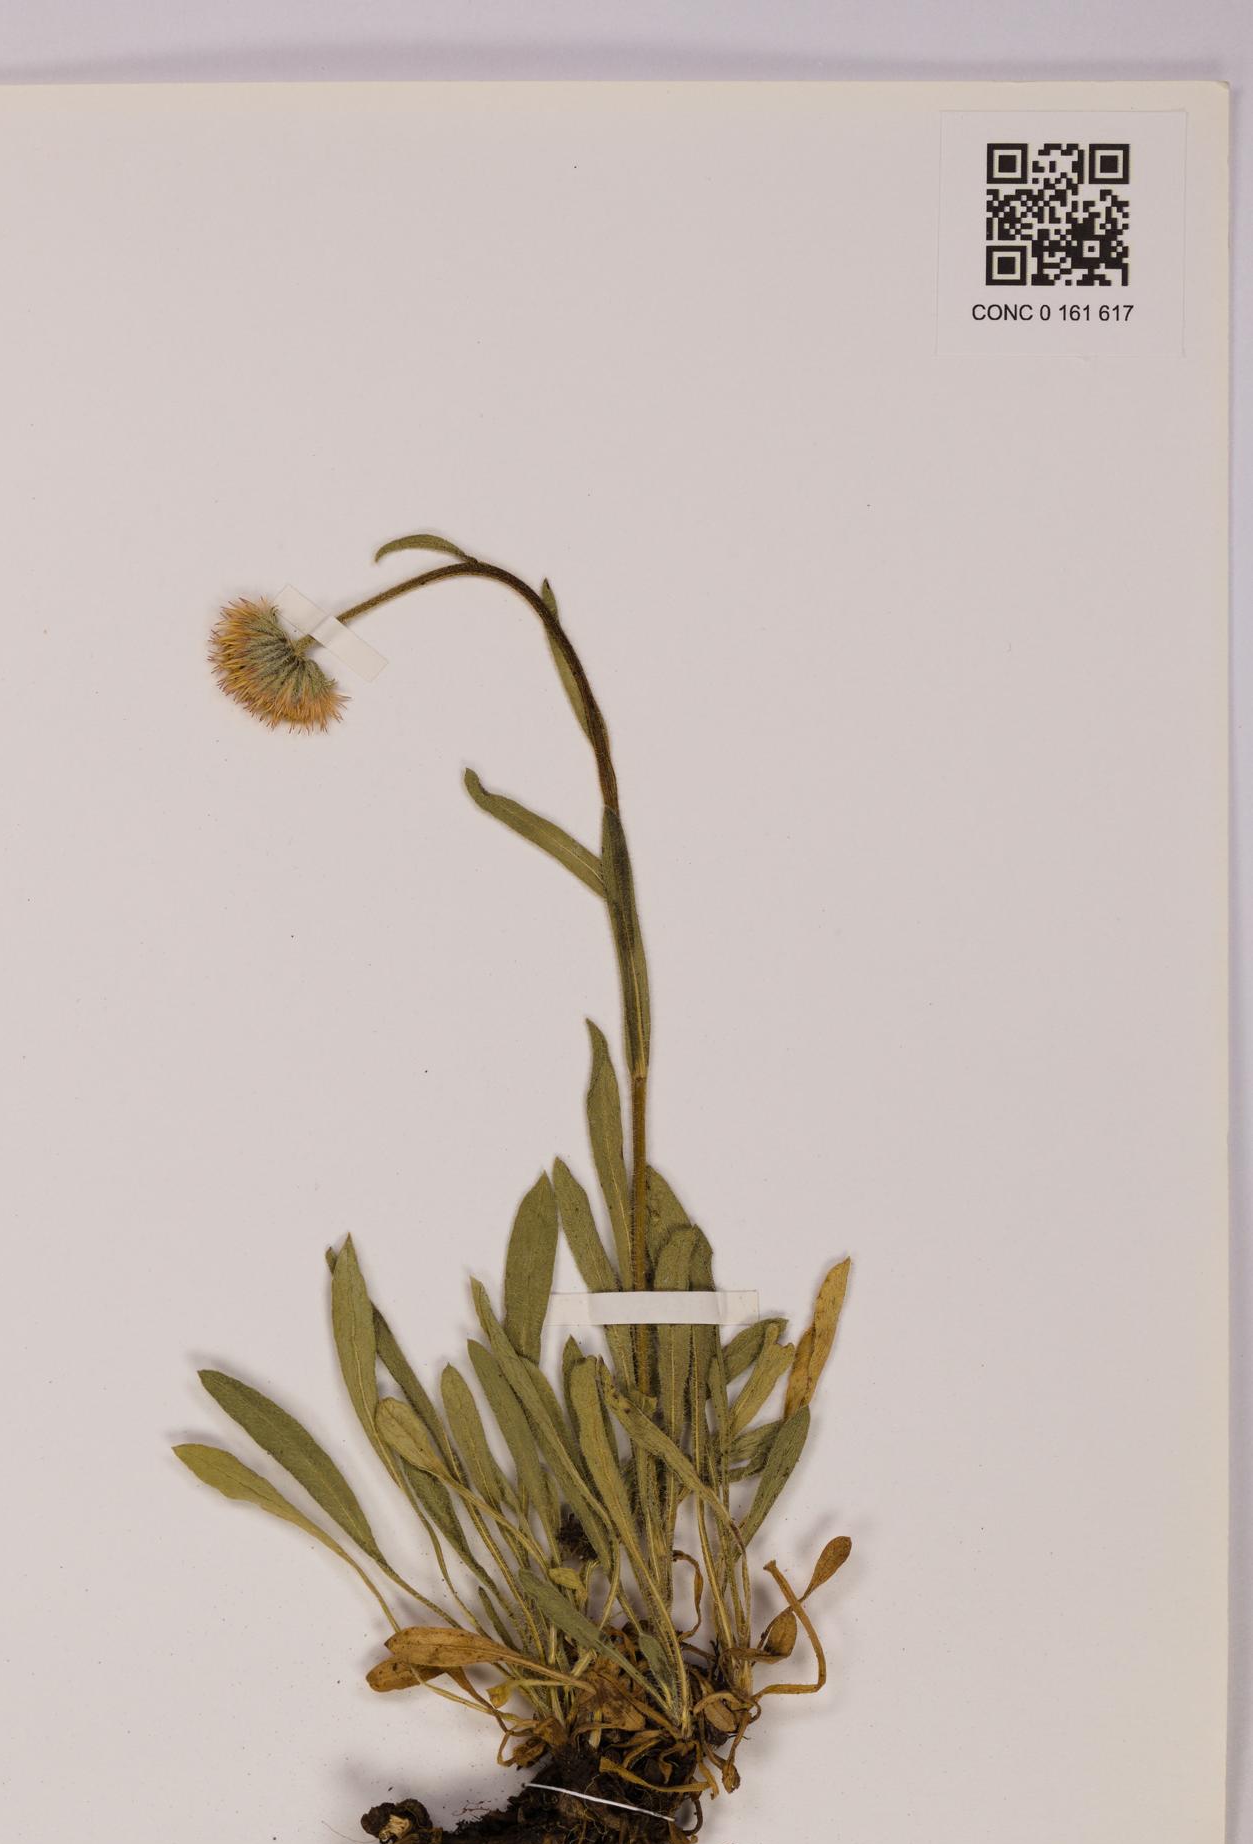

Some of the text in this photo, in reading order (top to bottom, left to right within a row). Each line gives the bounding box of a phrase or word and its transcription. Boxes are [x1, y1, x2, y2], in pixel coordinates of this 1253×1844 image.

[972, 304, 1134, 321] CONC 0 161 617
